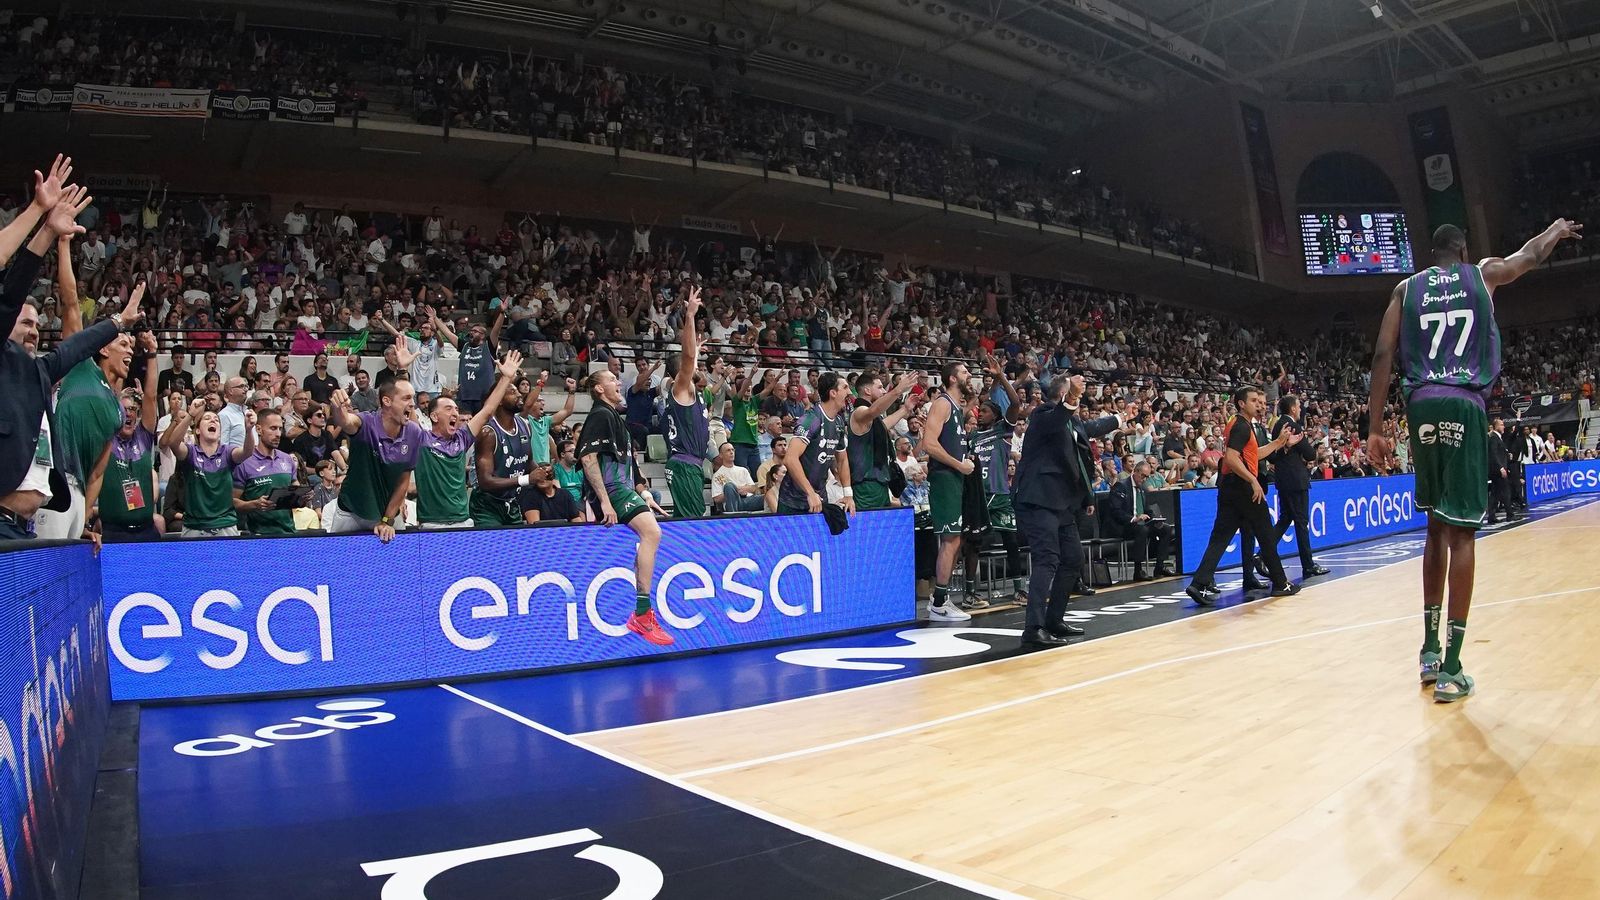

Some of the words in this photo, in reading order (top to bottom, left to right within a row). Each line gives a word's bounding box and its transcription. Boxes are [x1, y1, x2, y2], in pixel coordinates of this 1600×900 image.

[1339, 234, 1350, 244] 80
[1364, 233, 1376, 243] 85
[1428, 272, 1460, 286] Sima
[1419, 309, 1475, 360] 77
[981, 466, 989, 480] 5
[1570, 469, 1600, 488] es
[1343, 484, 1413, 532] endesa
[172, 697, 397, 758] acb
